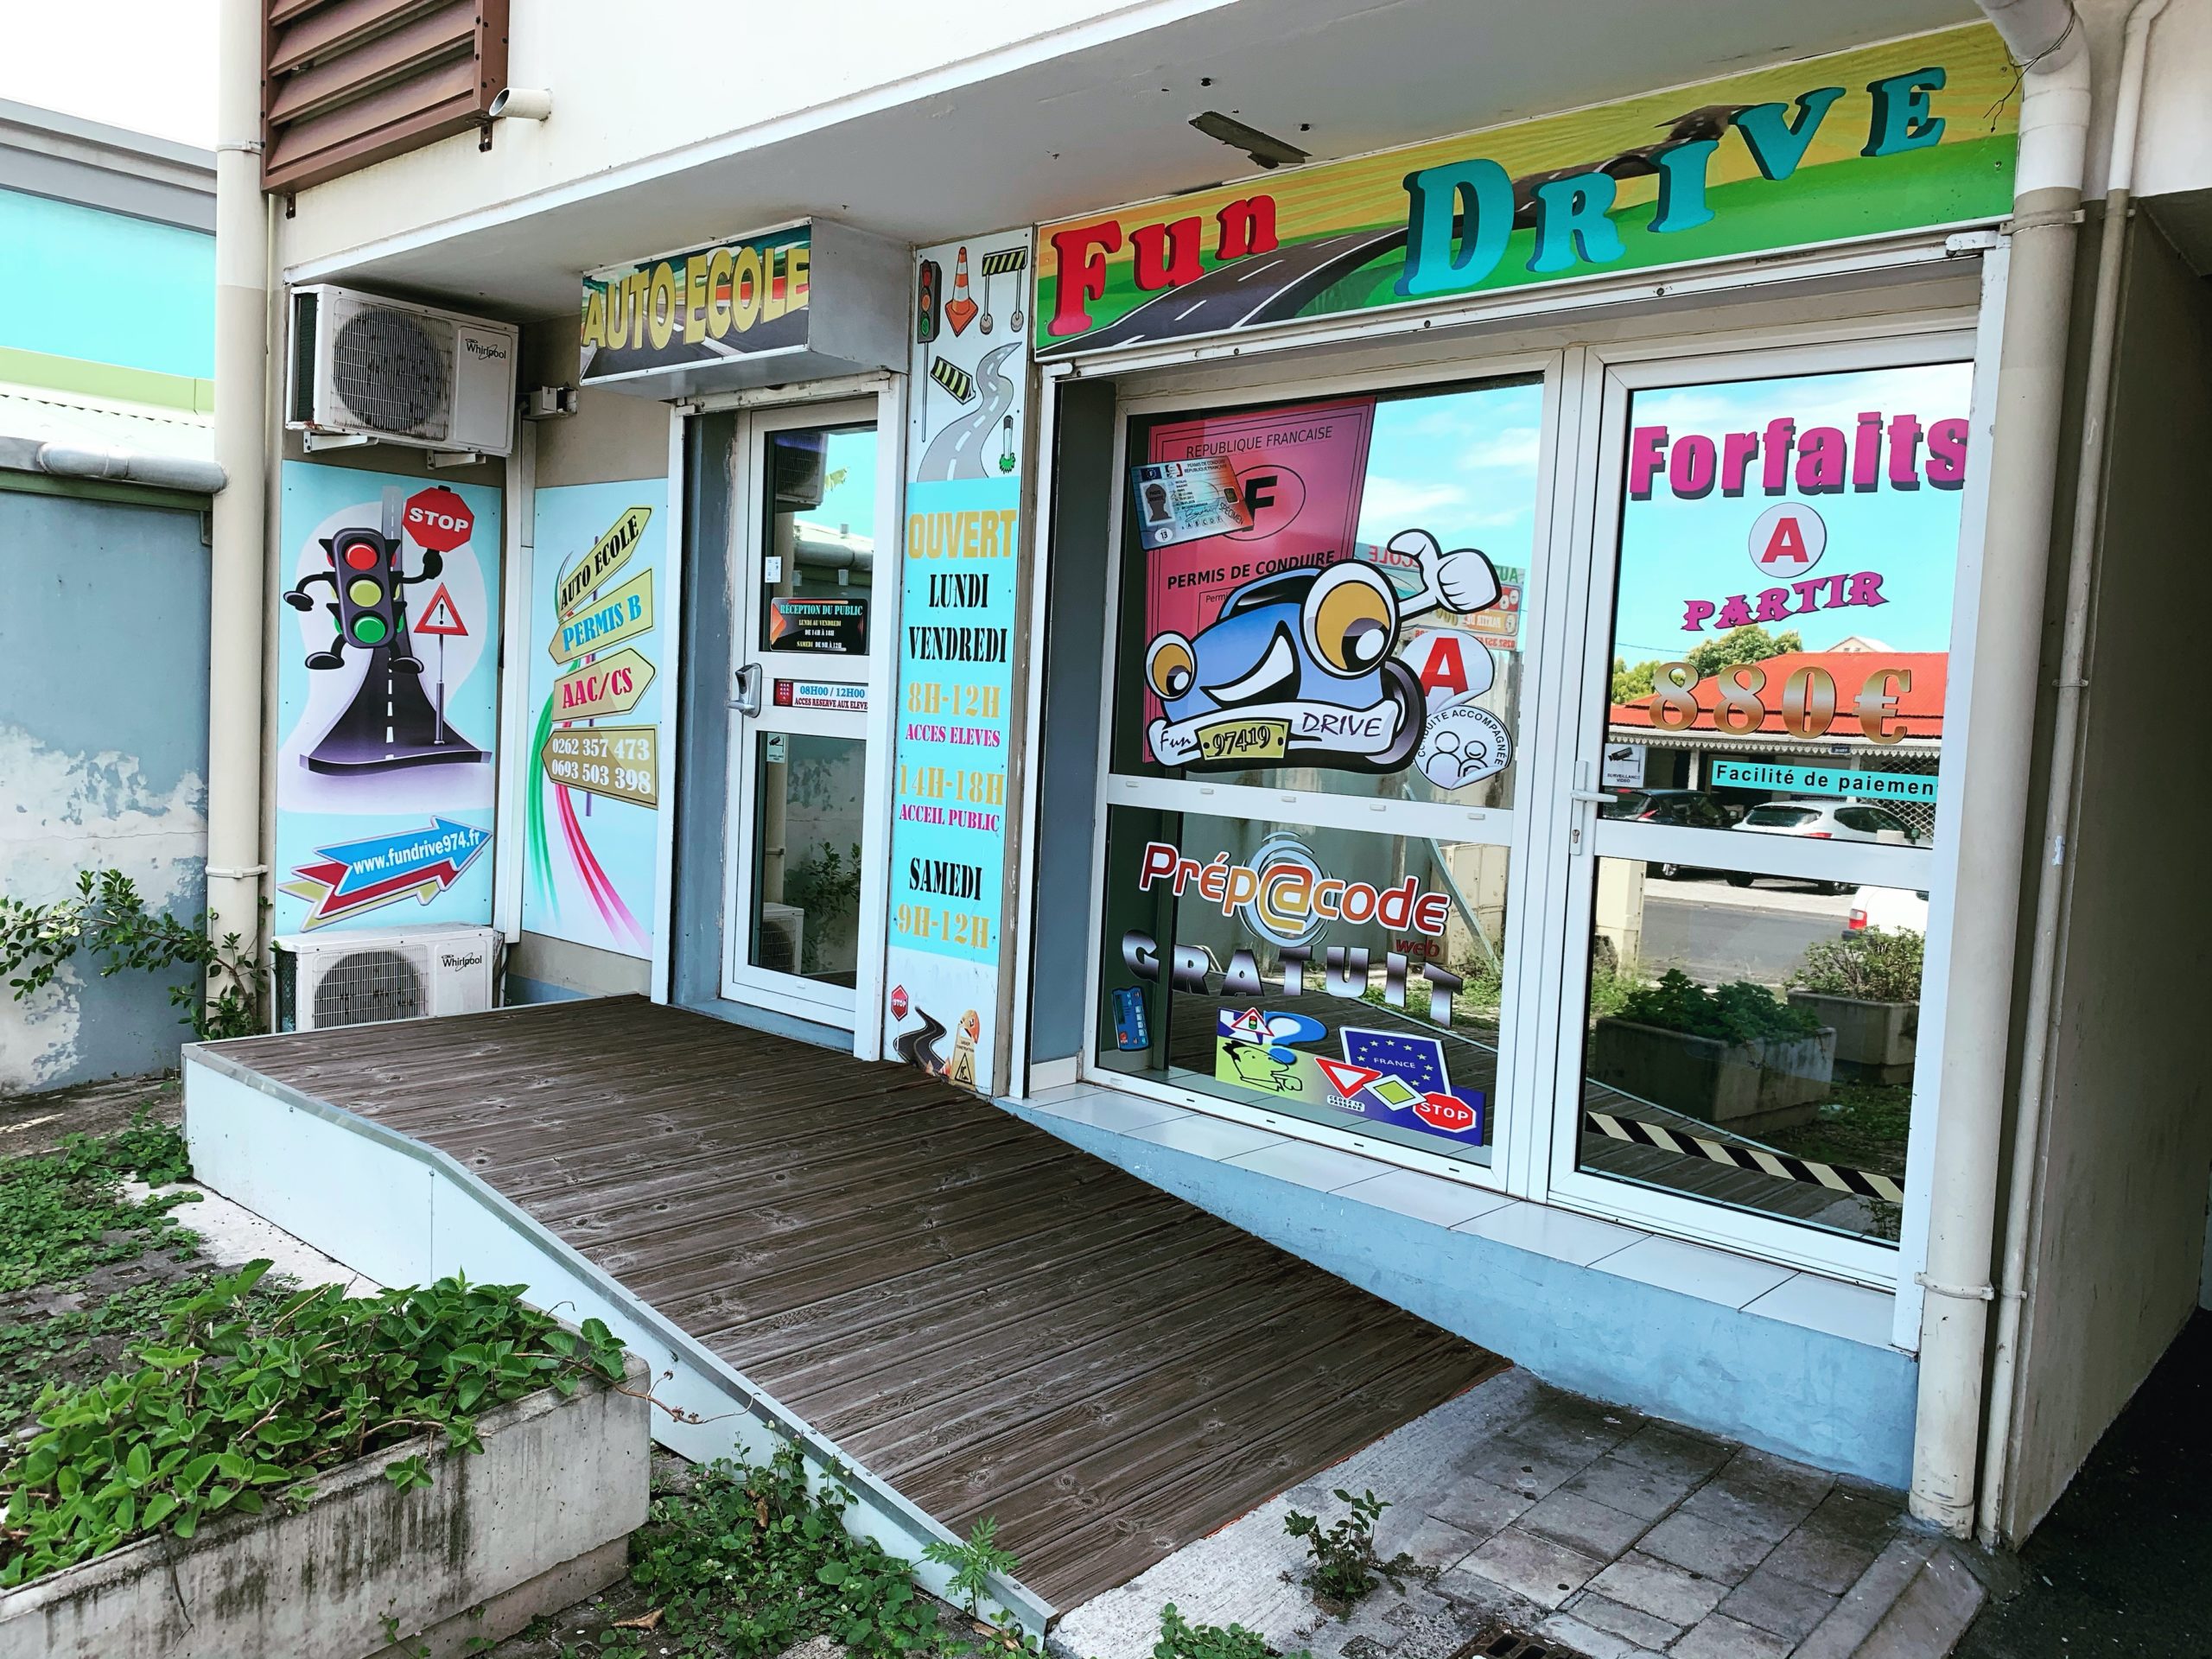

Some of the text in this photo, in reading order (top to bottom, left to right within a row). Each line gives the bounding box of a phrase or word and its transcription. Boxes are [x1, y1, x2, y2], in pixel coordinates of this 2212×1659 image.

[1047, 66, 1946, 336] Fun DRIVE
[582, 245, 810, 350] AUTO ECOLE
[466, 342, 506, 359] Whirlpool
[1186, 425, 1333, 459] REPUBLIQUE FRANCAISE
[1629, 411, 1969, 500] Forfaits
[409, 507, 469, 533] STOP
[908, 509, 1017, 559] OUVERT
[1761, 517, 1809, 563] A
[560, 515, 639, 611] AUTO ECOLE
[1167, 550, 1335, 590] PERMIS DE CONDUIRE
[929, 574, 988, 607] LUNDI
[1205, 593, 1230, 603] Permi
[1681, 570, 1890, 632] PARTIR
[563, 594, 642, 652] PERMIS B
[823, 605, 833, 614] DU
[835, 606, 862, 615] PUBLIC
[909, 626, 1007, 663] VENDREDI
[1420, 637, 1469, 697] A
[563, 667, 633, 709] AAC/CS
[800, 685, 829, 696] 08H00
[836, 688, 865, 698] 12H00
[812, 698, 836, 707] RESERVE
[907, 682, 1001, 718] 8H-12H
[1648, 661, 1911, 746] 880€
[906, 723, 1001, 747] ACCES ELEVES
[1160, 726, 1192, 752] Fun
[1212, 725, 1270, 756] 97419
[1301, 712, 1382, 737] DRIVE
[1417, 709, 1508, 766] CODUITE ACCOMPAGNÉE
[552, 738, 650, 760] 0262 357 473
[551, 759, 651, 794] 0693 503 398
[899, 765, 1005, 805] 14H-18H
[1716, 765, 1938, 796] Facilité de paiemen
[899, 804, 1000, 832] ACCEIL PUBLIC
[353, 830, 480, 875] www.fundrive974.fr
[909, 856, 982, 900] SAMEDI
[1139, 842, 1452, 936] Prép@code
[897, 903, 990, 949] 9H-12H
[442, 954, 482, 969] Whirlpool
[1395, 938, 1440, 957] web
[1123, 929, 1464, 1027] GRATUIT
[893, 999, 906, 1007] STOP
[1373, 1057, 1416, 1069] FRANCE
[1330, 1100, 1362, 1111] PASSAGE
[1420, 1102, 1469, 1122] STOP
